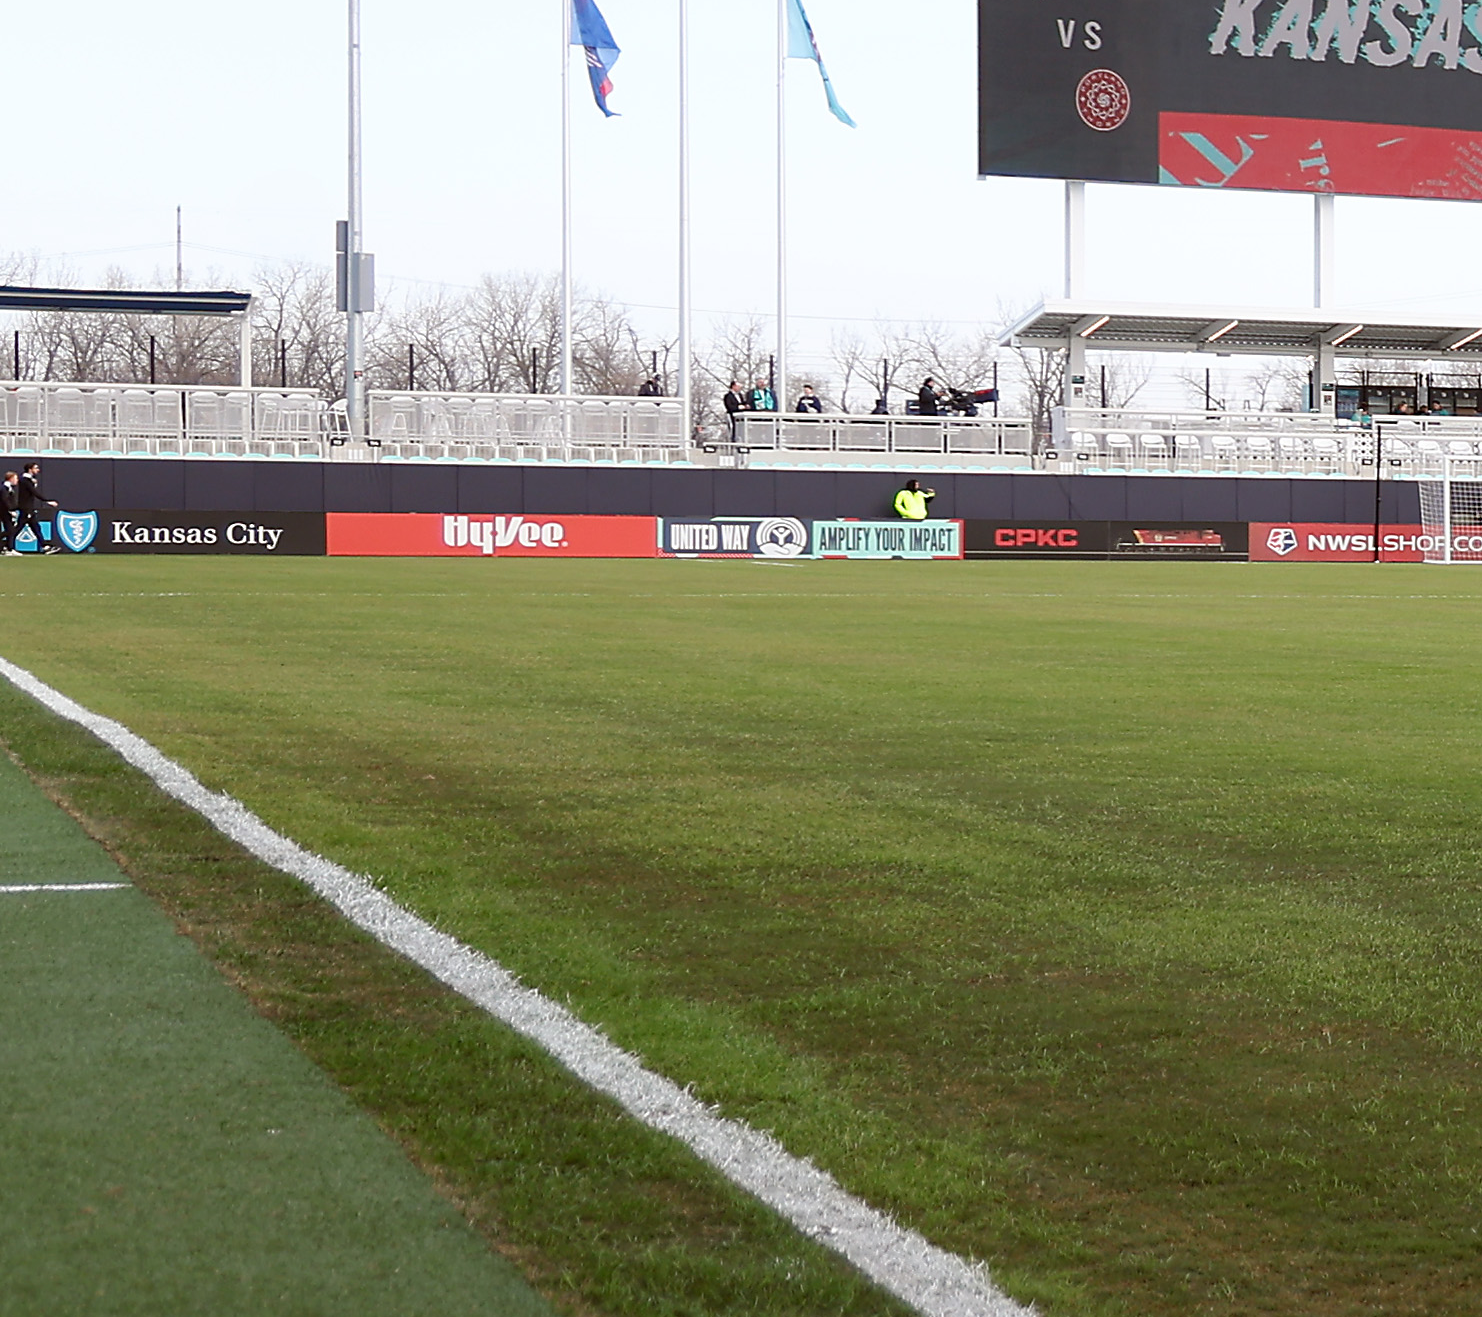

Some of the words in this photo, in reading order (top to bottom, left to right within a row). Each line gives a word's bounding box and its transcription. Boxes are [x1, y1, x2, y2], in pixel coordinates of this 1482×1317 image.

[112, 521, 217, 544] Kansas
[226, 522, 284, 550] City
[670, 524, 718, 551] UNITED
[720, 524, 751, 551] WAY
[819, 528, 871, 552] AMPLIFY
[874, 528, 906, 552] YOUR
[909, 527, 954, 552] IMPACT
[994, 528, 1079, 547] CPKC
